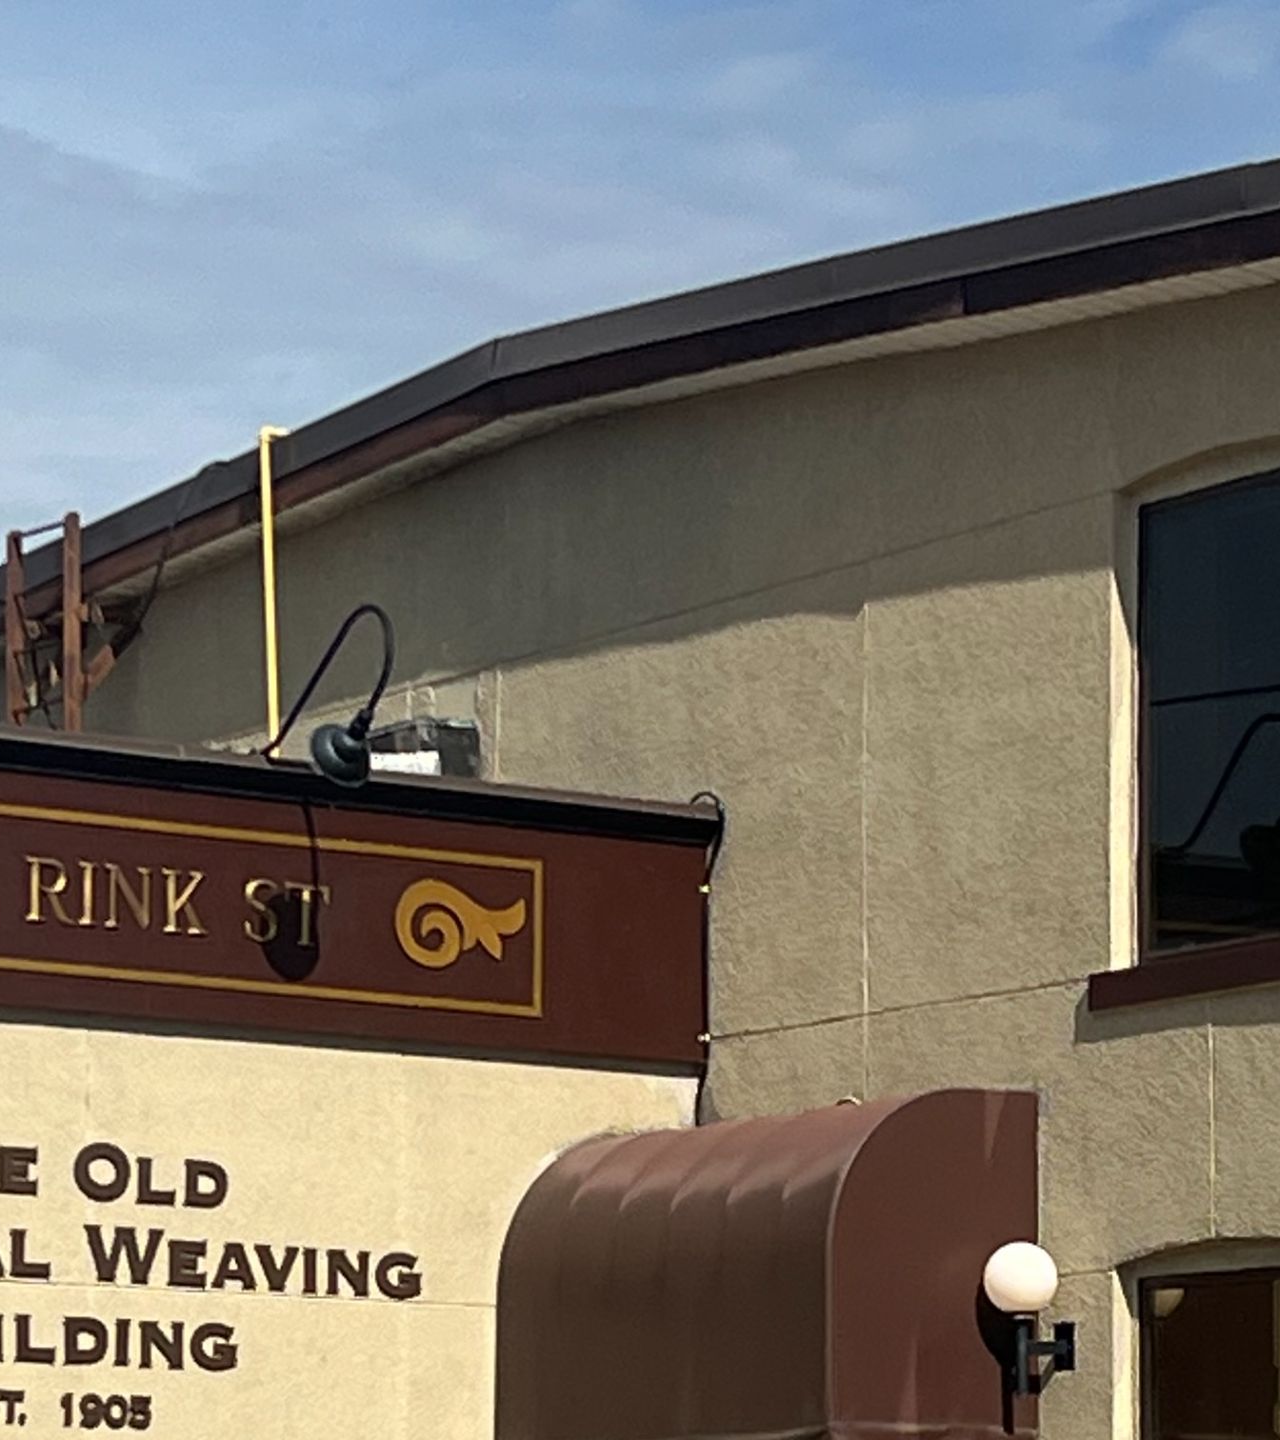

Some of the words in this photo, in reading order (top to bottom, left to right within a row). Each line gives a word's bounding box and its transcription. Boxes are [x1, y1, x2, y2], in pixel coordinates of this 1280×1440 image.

[24, 855, 208, 937] RINK
[243, 877, 331, 947] ST
[74, 1143, 227, 1208] OLD
[84, 1225, 422, 1301] WEAVING
[61, 1393, 151, 1430] 1905
